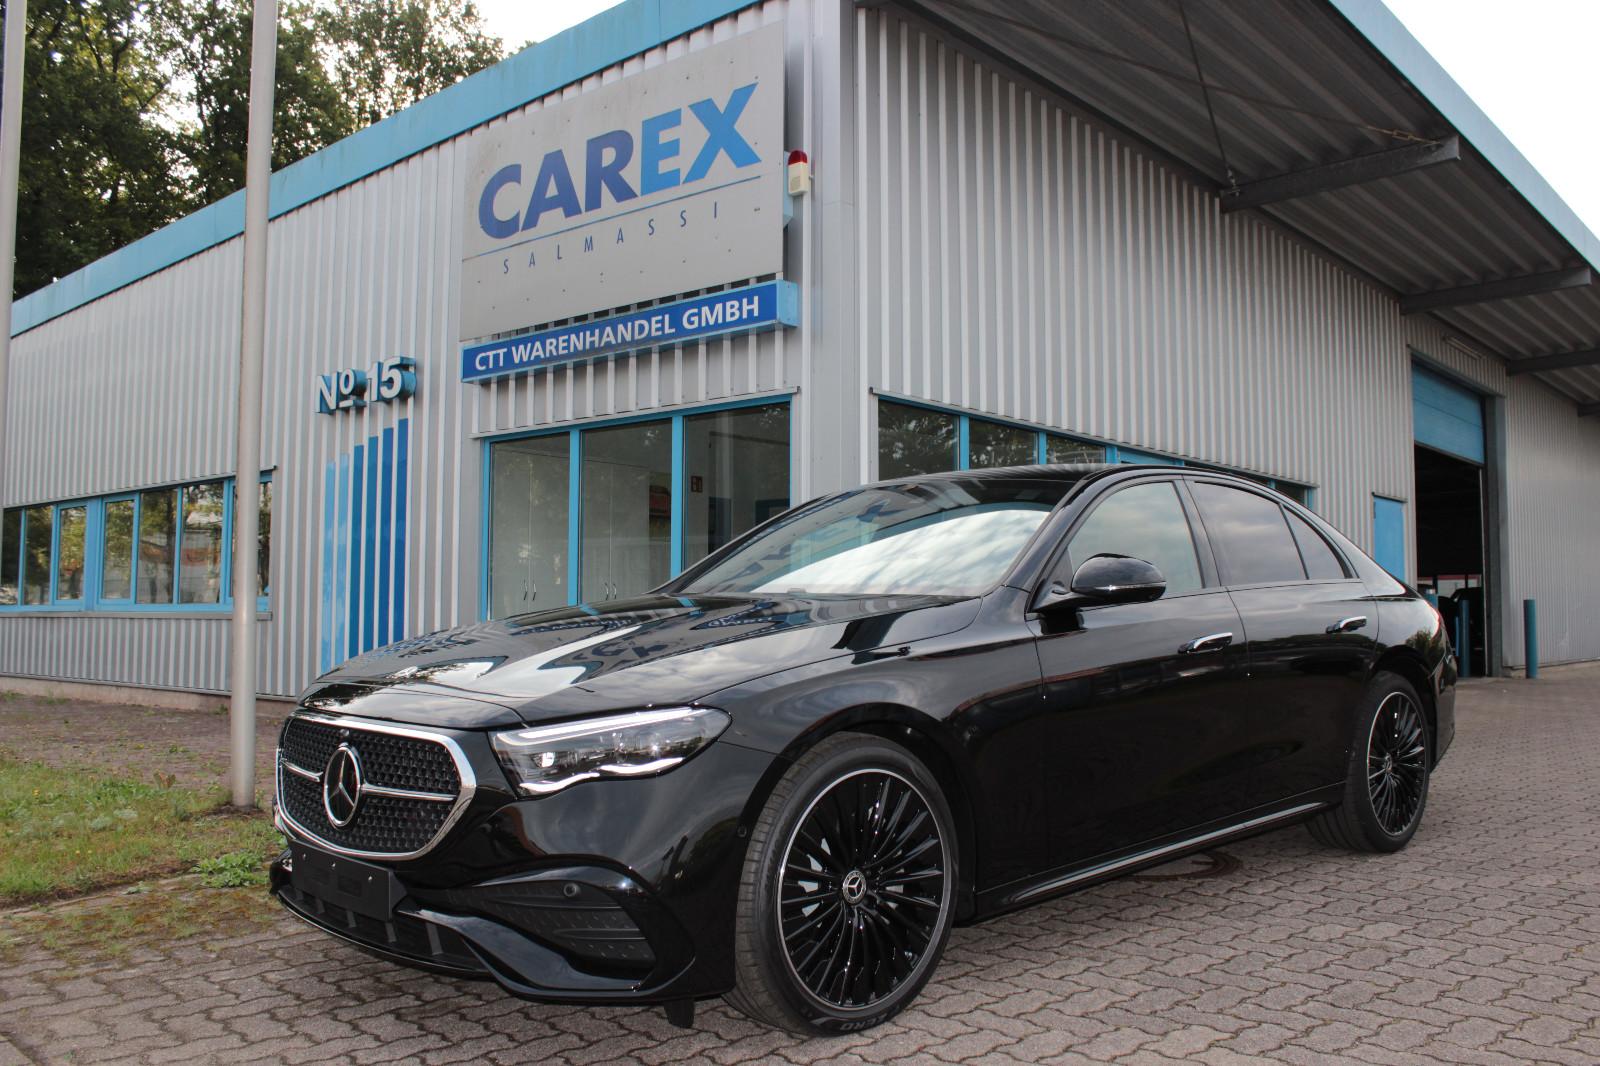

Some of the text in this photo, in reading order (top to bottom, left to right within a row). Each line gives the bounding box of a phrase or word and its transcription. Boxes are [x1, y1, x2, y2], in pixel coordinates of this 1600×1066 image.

[478, 82, 762, 239] CAREX
[503, 201, 718, 274] SALMASSI
[475, 295, 760, 371] CTT WARENHANDEL GMBH
[368, 356, 403, 402] 15
